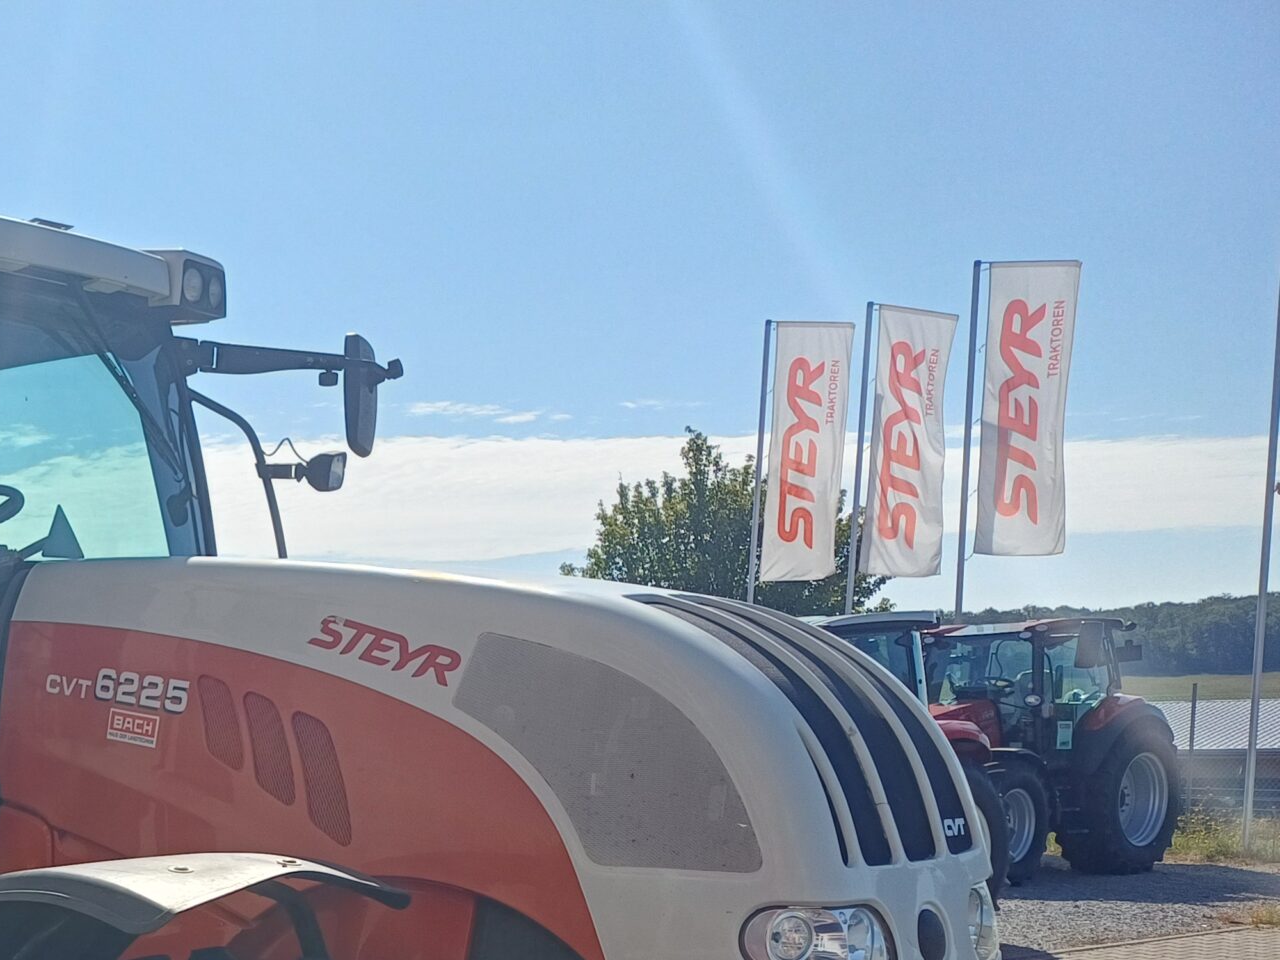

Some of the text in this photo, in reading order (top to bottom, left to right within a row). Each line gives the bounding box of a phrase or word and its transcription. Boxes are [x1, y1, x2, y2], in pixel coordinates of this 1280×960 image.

[1047, 300, 1065, 379] TRAKTOREN
[825, 360, 840, 425] TRAKTOREN
[924, 348, 939, 417] TRAKTOREN
[996, 299, 1047, 525] STEYR
[777, 357, 825, 550] STEYR
[878, 341, 926, 549] STEYR
[307, 615, 462, 687] STEYR
[46, 668, 190, 714] CVT 6225
[113, 715, 153, 735] BACH
[944, 818, 965, 836] CVT
